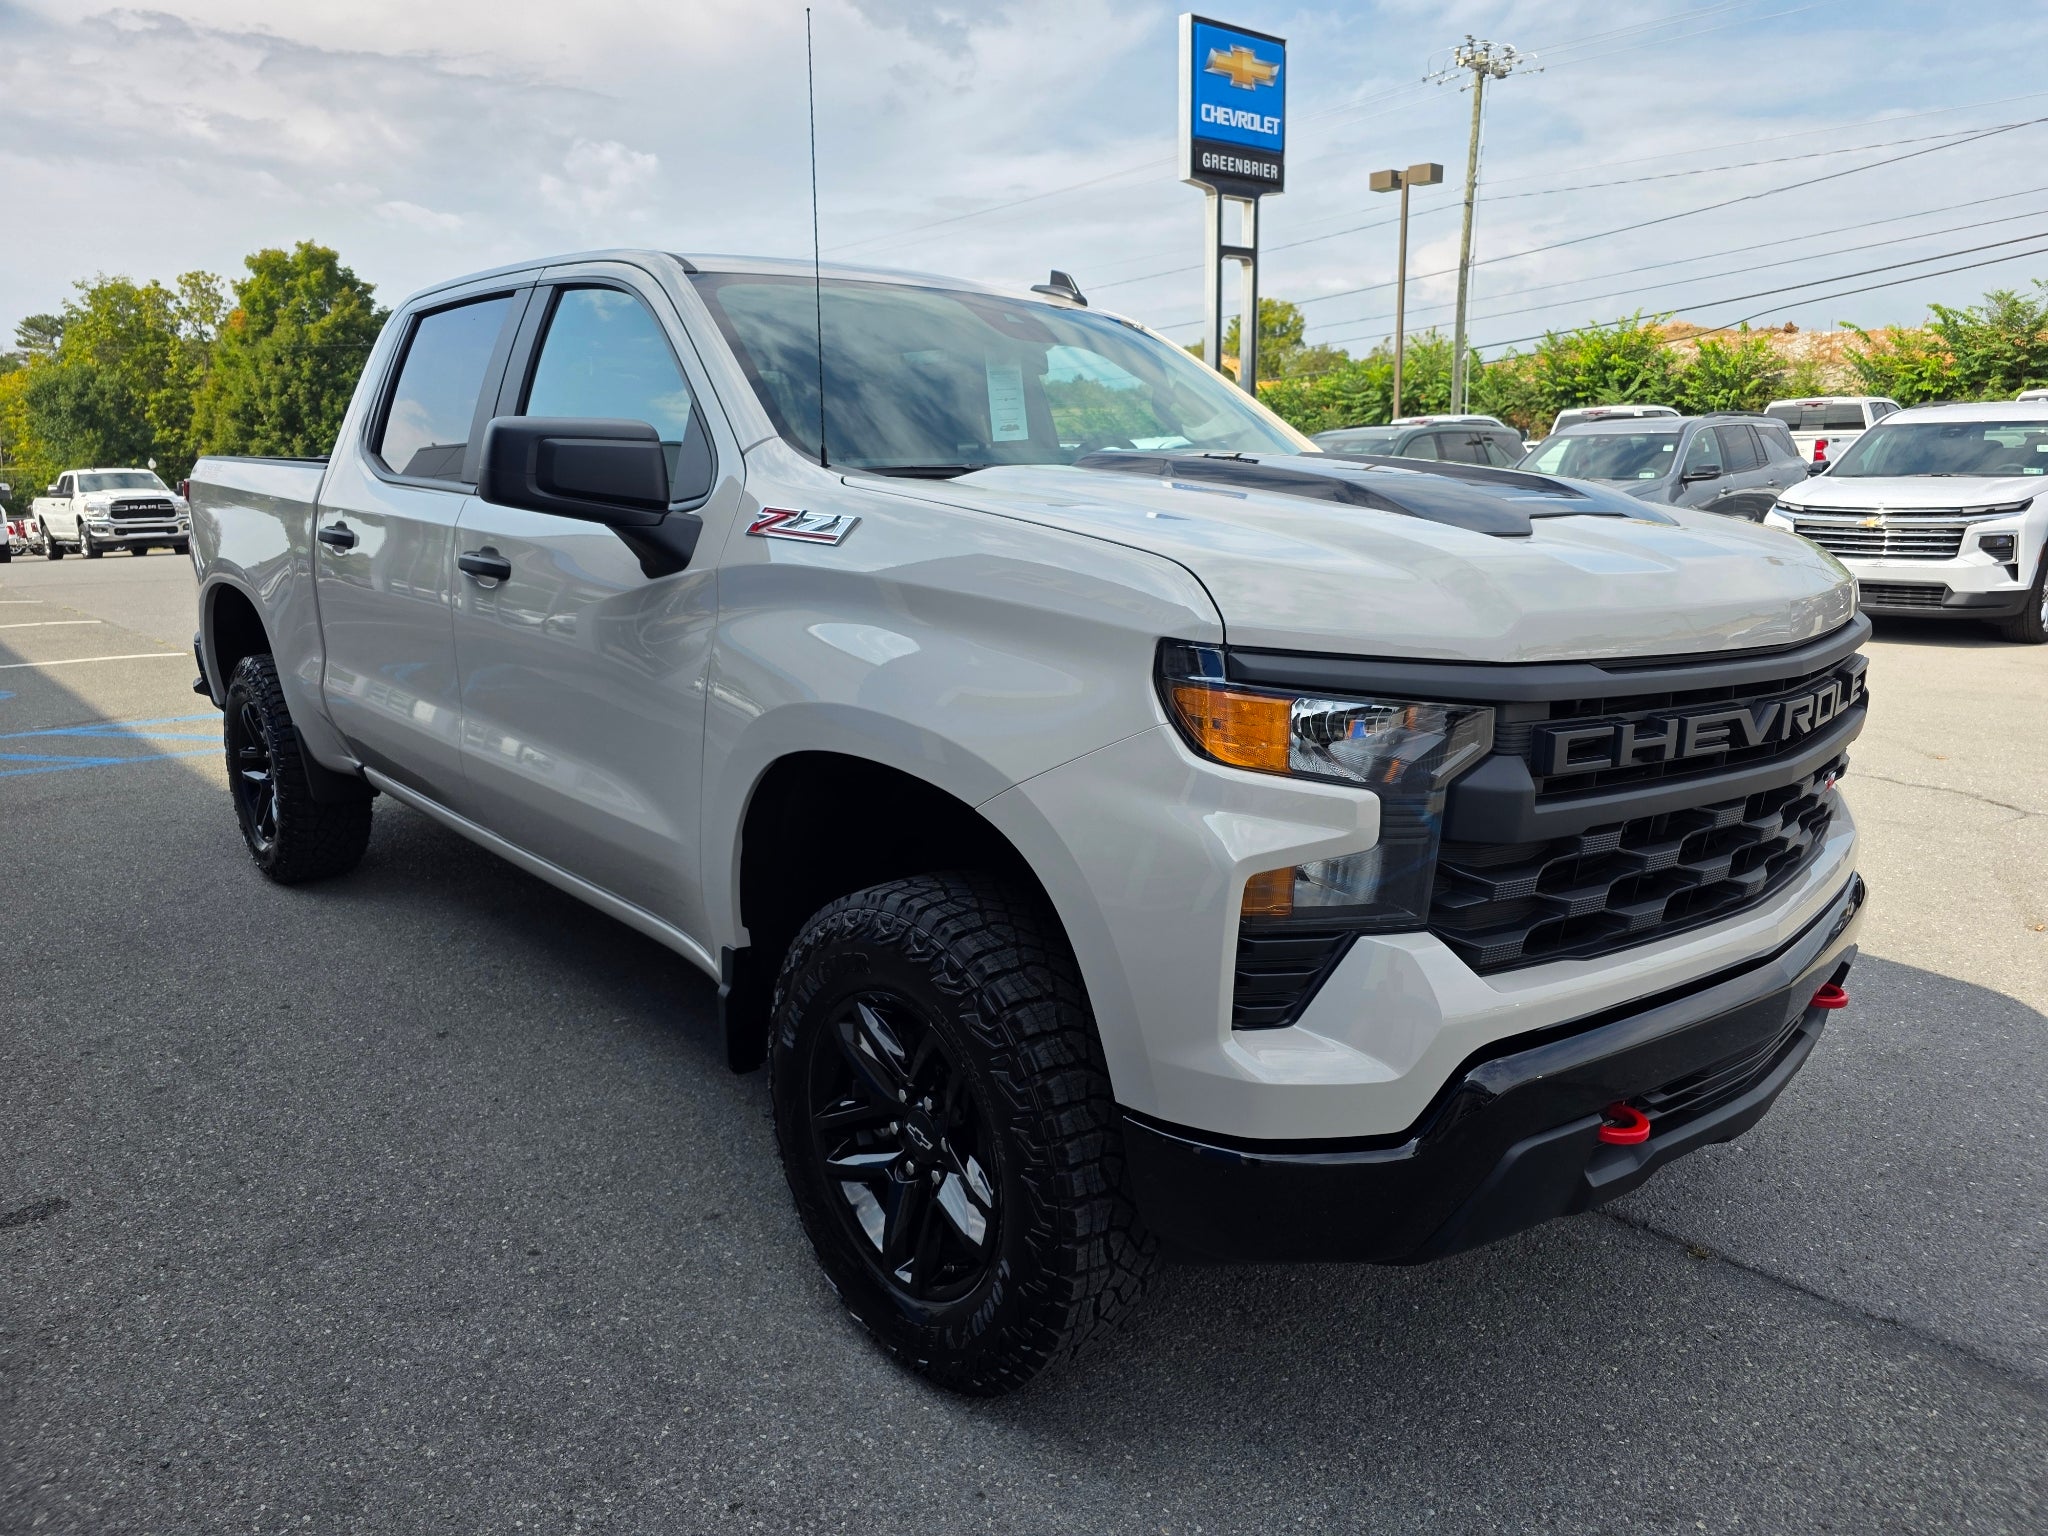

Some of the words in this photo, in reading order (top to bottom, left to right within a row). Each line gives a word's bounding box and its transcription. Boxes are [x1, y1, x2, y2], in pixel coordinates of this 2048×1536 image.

[1201, 103, 1280, 135] CHEVROLET
[1202, 152, 1278, 179] GREENBRIER
[745, 506, 862, 546] Z71
